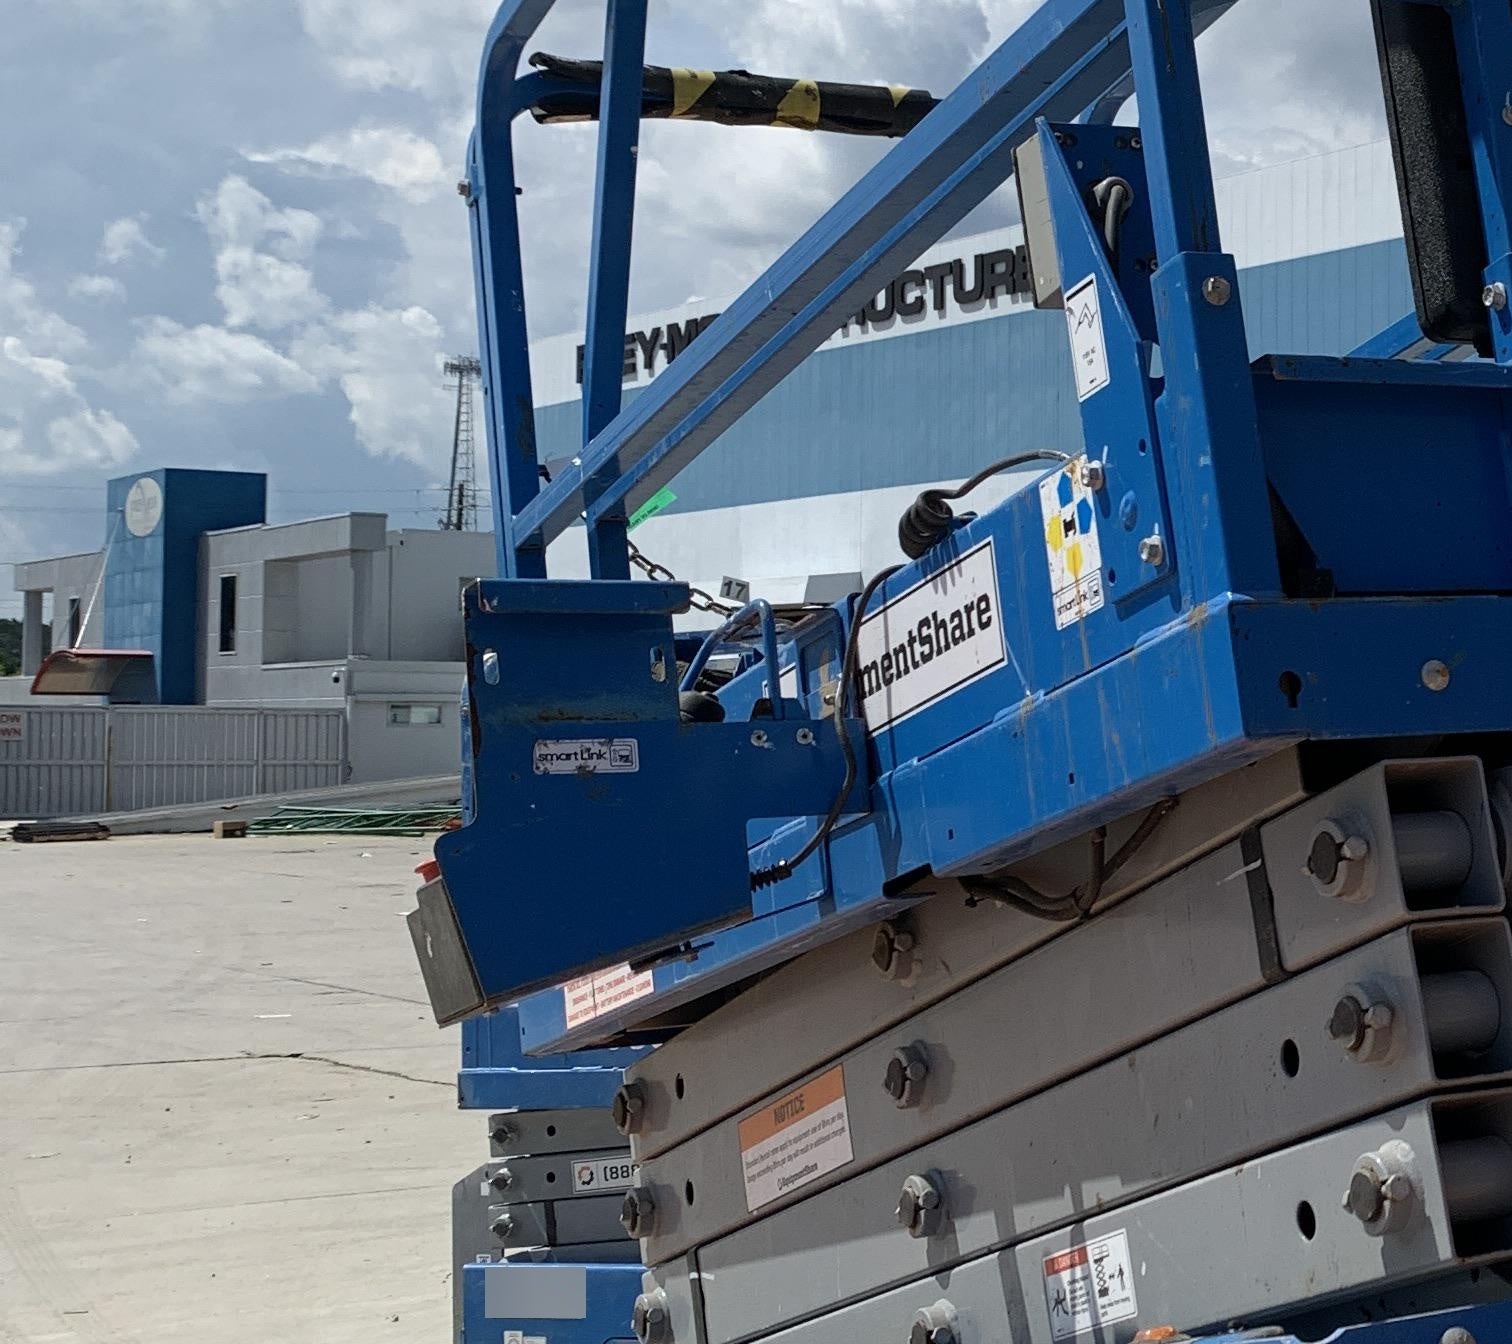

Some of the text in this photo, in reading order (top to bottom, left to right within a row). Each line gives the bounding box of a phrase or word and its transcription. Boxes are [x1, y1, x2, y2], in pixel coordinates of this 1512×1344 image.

[724, 580, 746, 599] 17
[859, 593, 992, 698] mentShare
[774, 1094, 805, 1126] NOTICE
